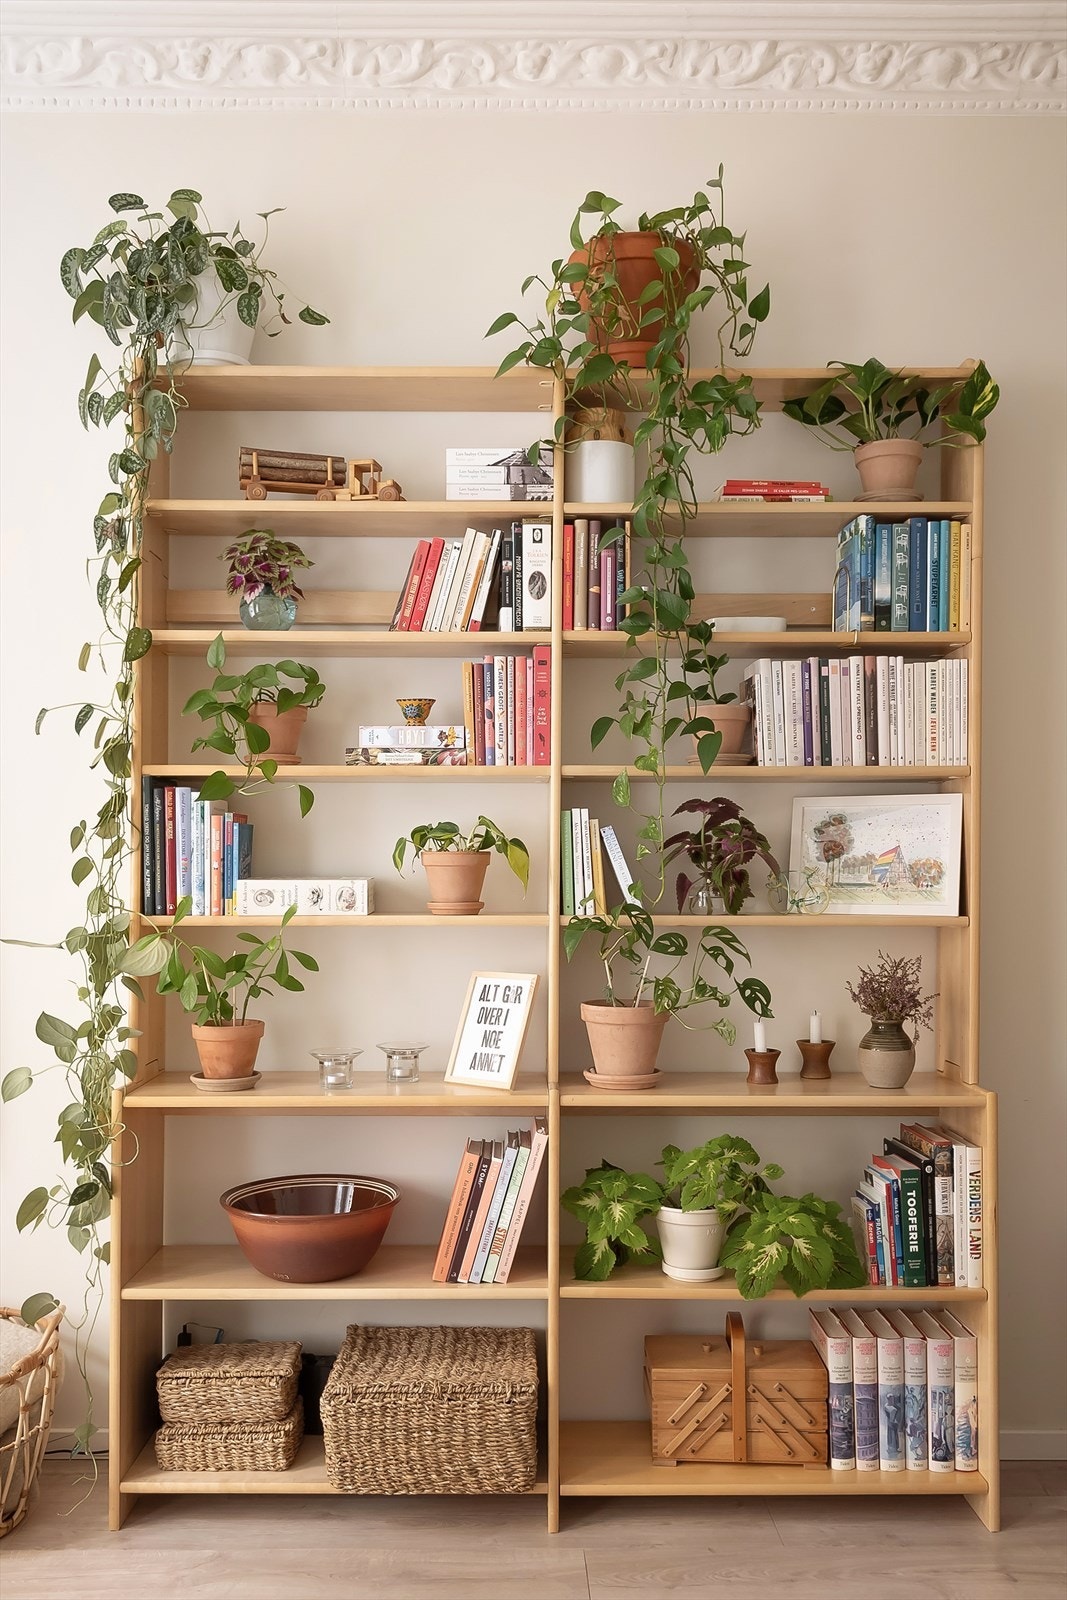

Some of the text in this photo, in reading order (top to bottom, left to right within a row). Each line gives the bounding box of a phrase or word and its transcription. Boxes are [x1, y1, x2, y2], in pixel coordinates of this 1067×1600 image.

[398, 730, 426, 744] HØYT
[479, 984, 500, 1002] ALT
[477, 1006, 510, 1026] OVER I
[481, 1030, 504, 1049] NOE
[469, 1052, 506, 1073] ANNET
[514, 1199, 526, 1226] SKAPPEL
[907, 1190, 919, 1252] TOGFERIE
[969, 1170, 981, 1259] VERDENS LAND
